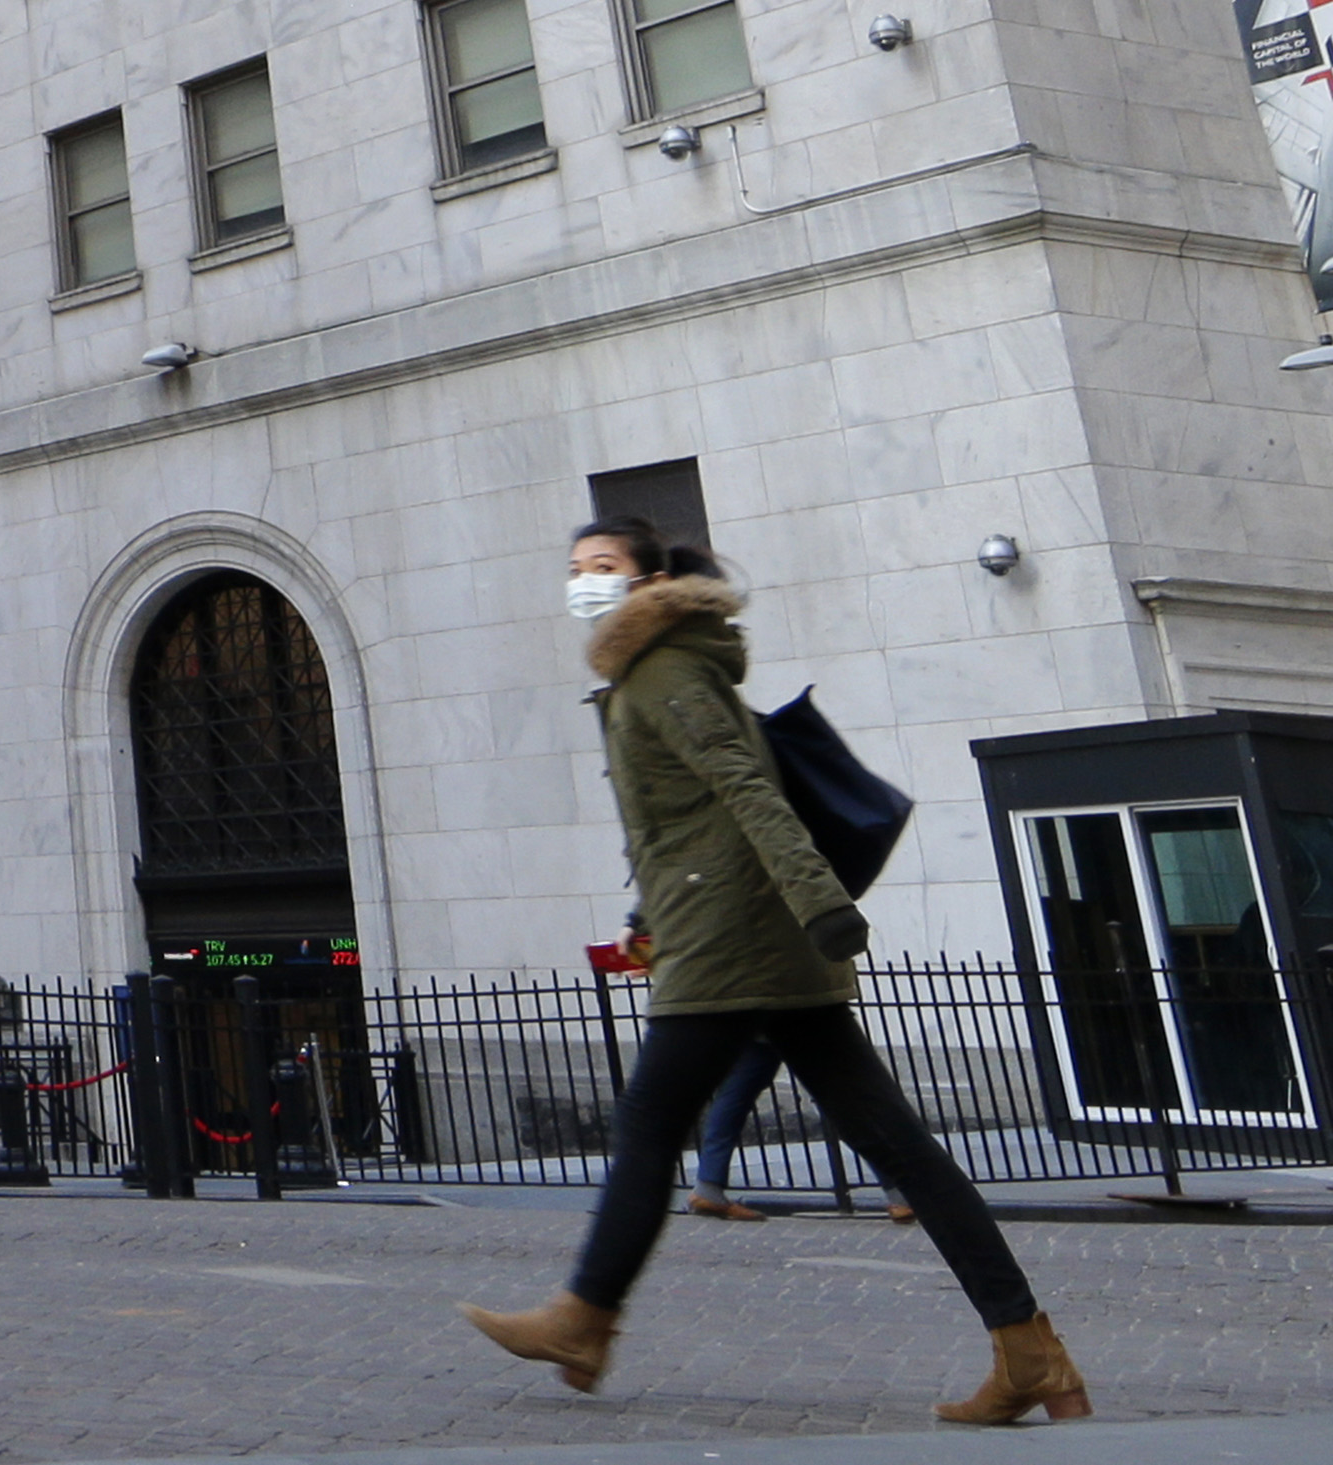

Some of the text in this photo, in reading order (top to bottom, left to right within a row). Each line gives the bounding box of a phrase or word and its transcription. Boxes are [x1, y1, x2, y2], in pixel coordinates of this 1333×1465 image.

[1252, 29, 1305, 50] FINANCIAL
[1253, 38, 1307, 59] CAPITAL OF
[1255, 47, 1310, 69] THE WORLD
[204, 938, 356, 951] TRV UNH
[206, 954, 241, 966] 107.45
[251, 954, 273, 966] 5.27
